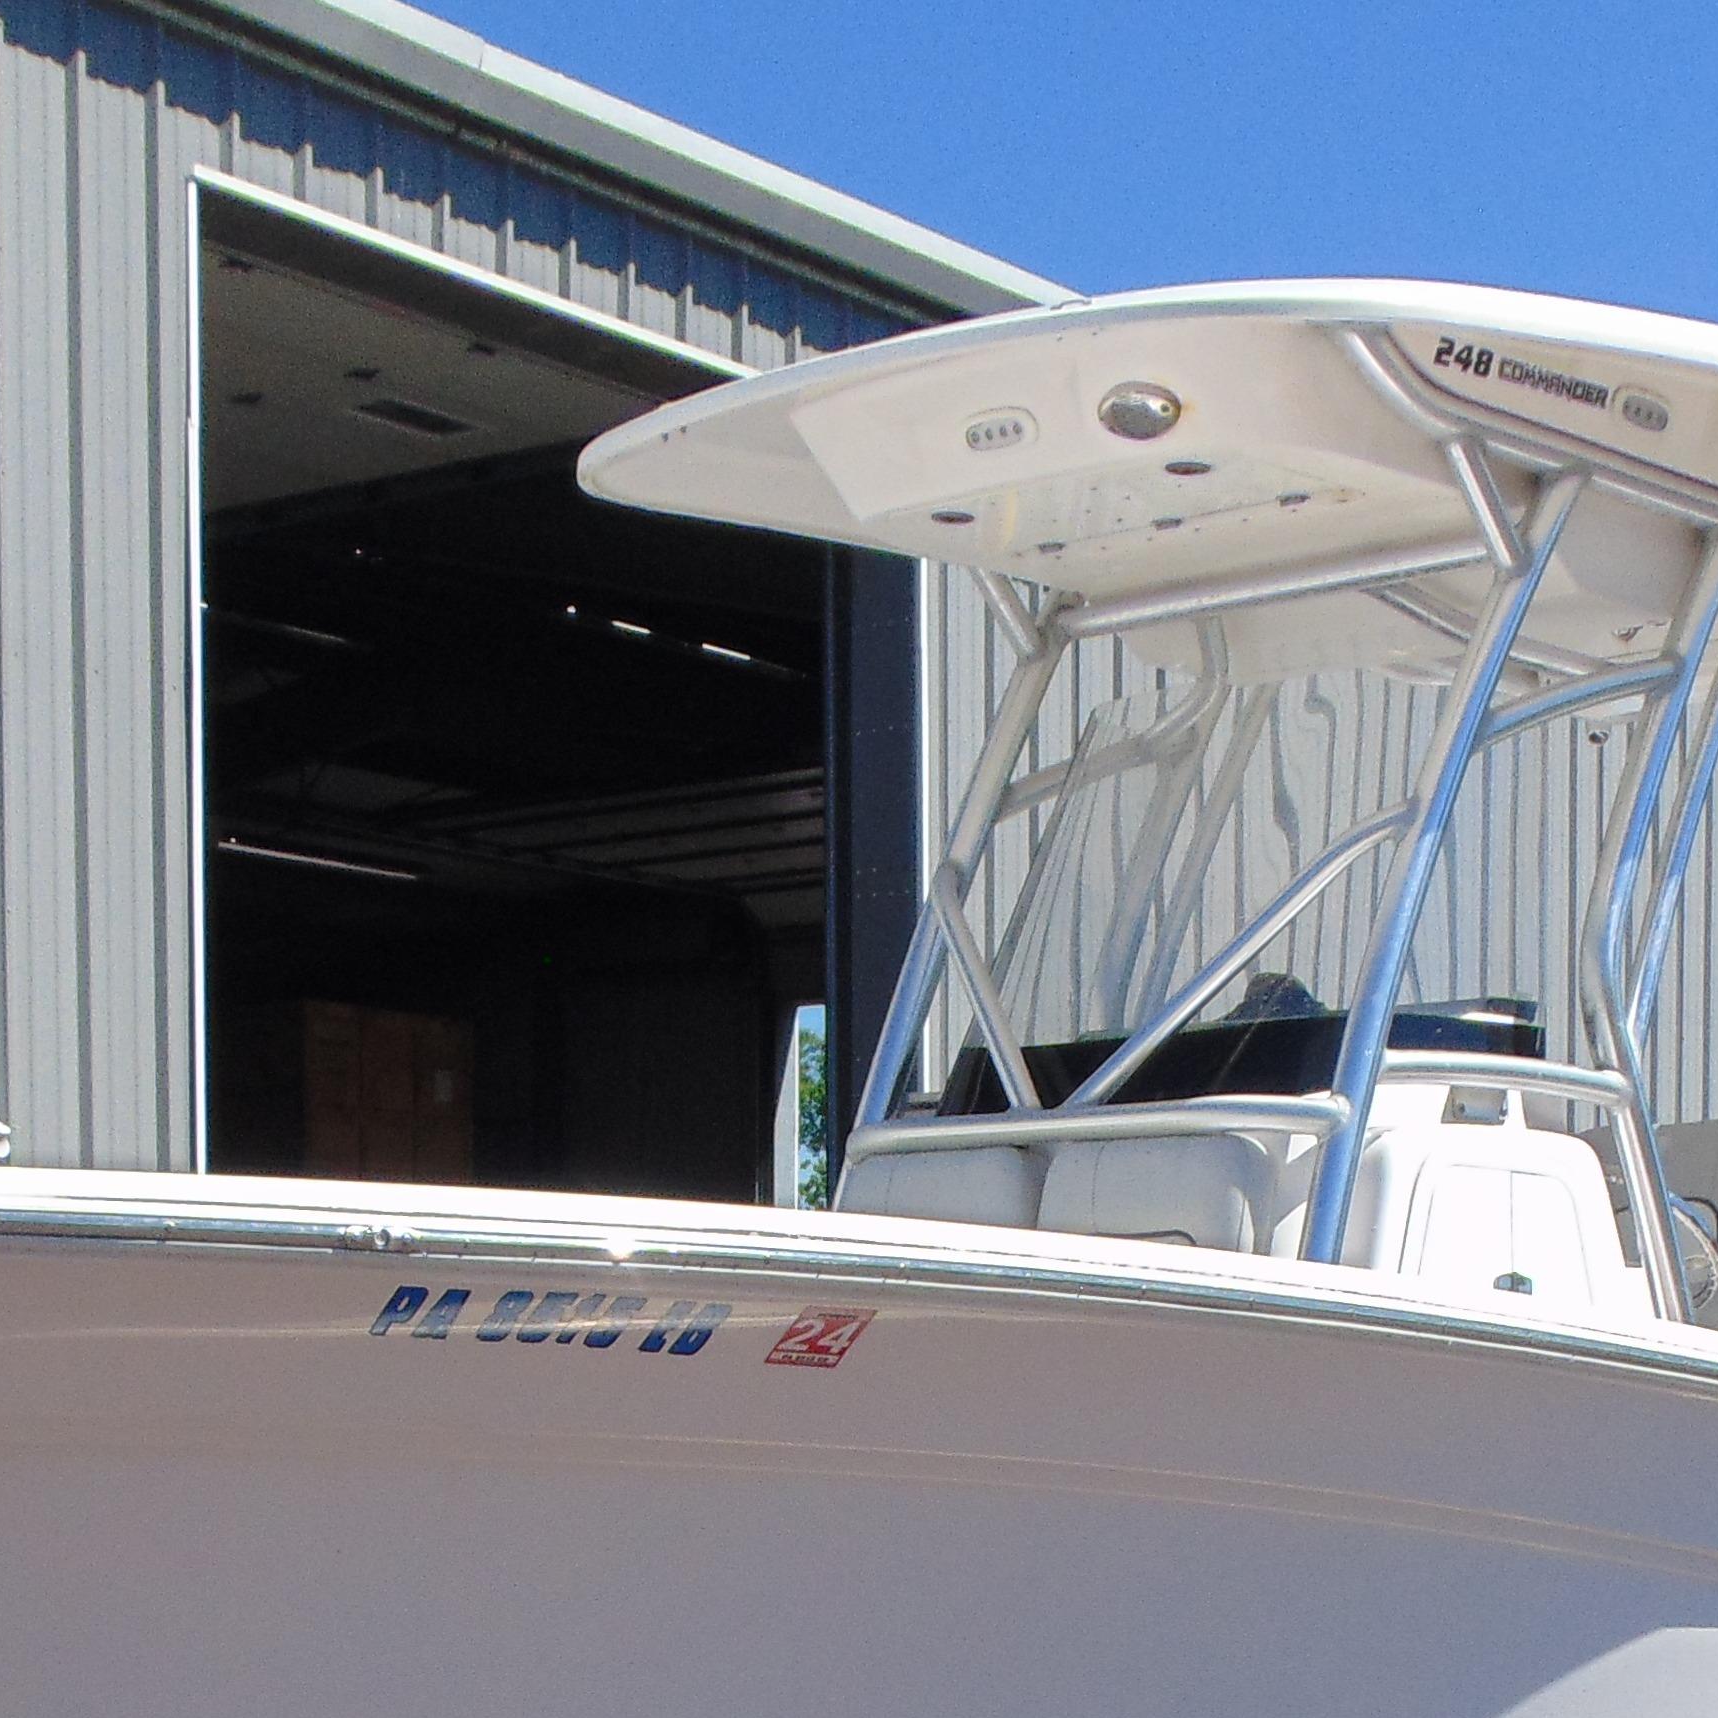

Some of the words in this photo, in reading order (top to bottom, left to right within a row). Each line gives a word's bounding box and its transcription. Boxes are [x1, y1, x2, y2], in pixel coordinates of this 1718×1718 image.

[1432, 335, 1495, 378] 248
[1497, 356, 1610, 410] COMMANDER
[368, 1285, 472, 1340] PA
[475, 1290, 649, 1349] 8515
[775, 1318, 862, 1355] 24
